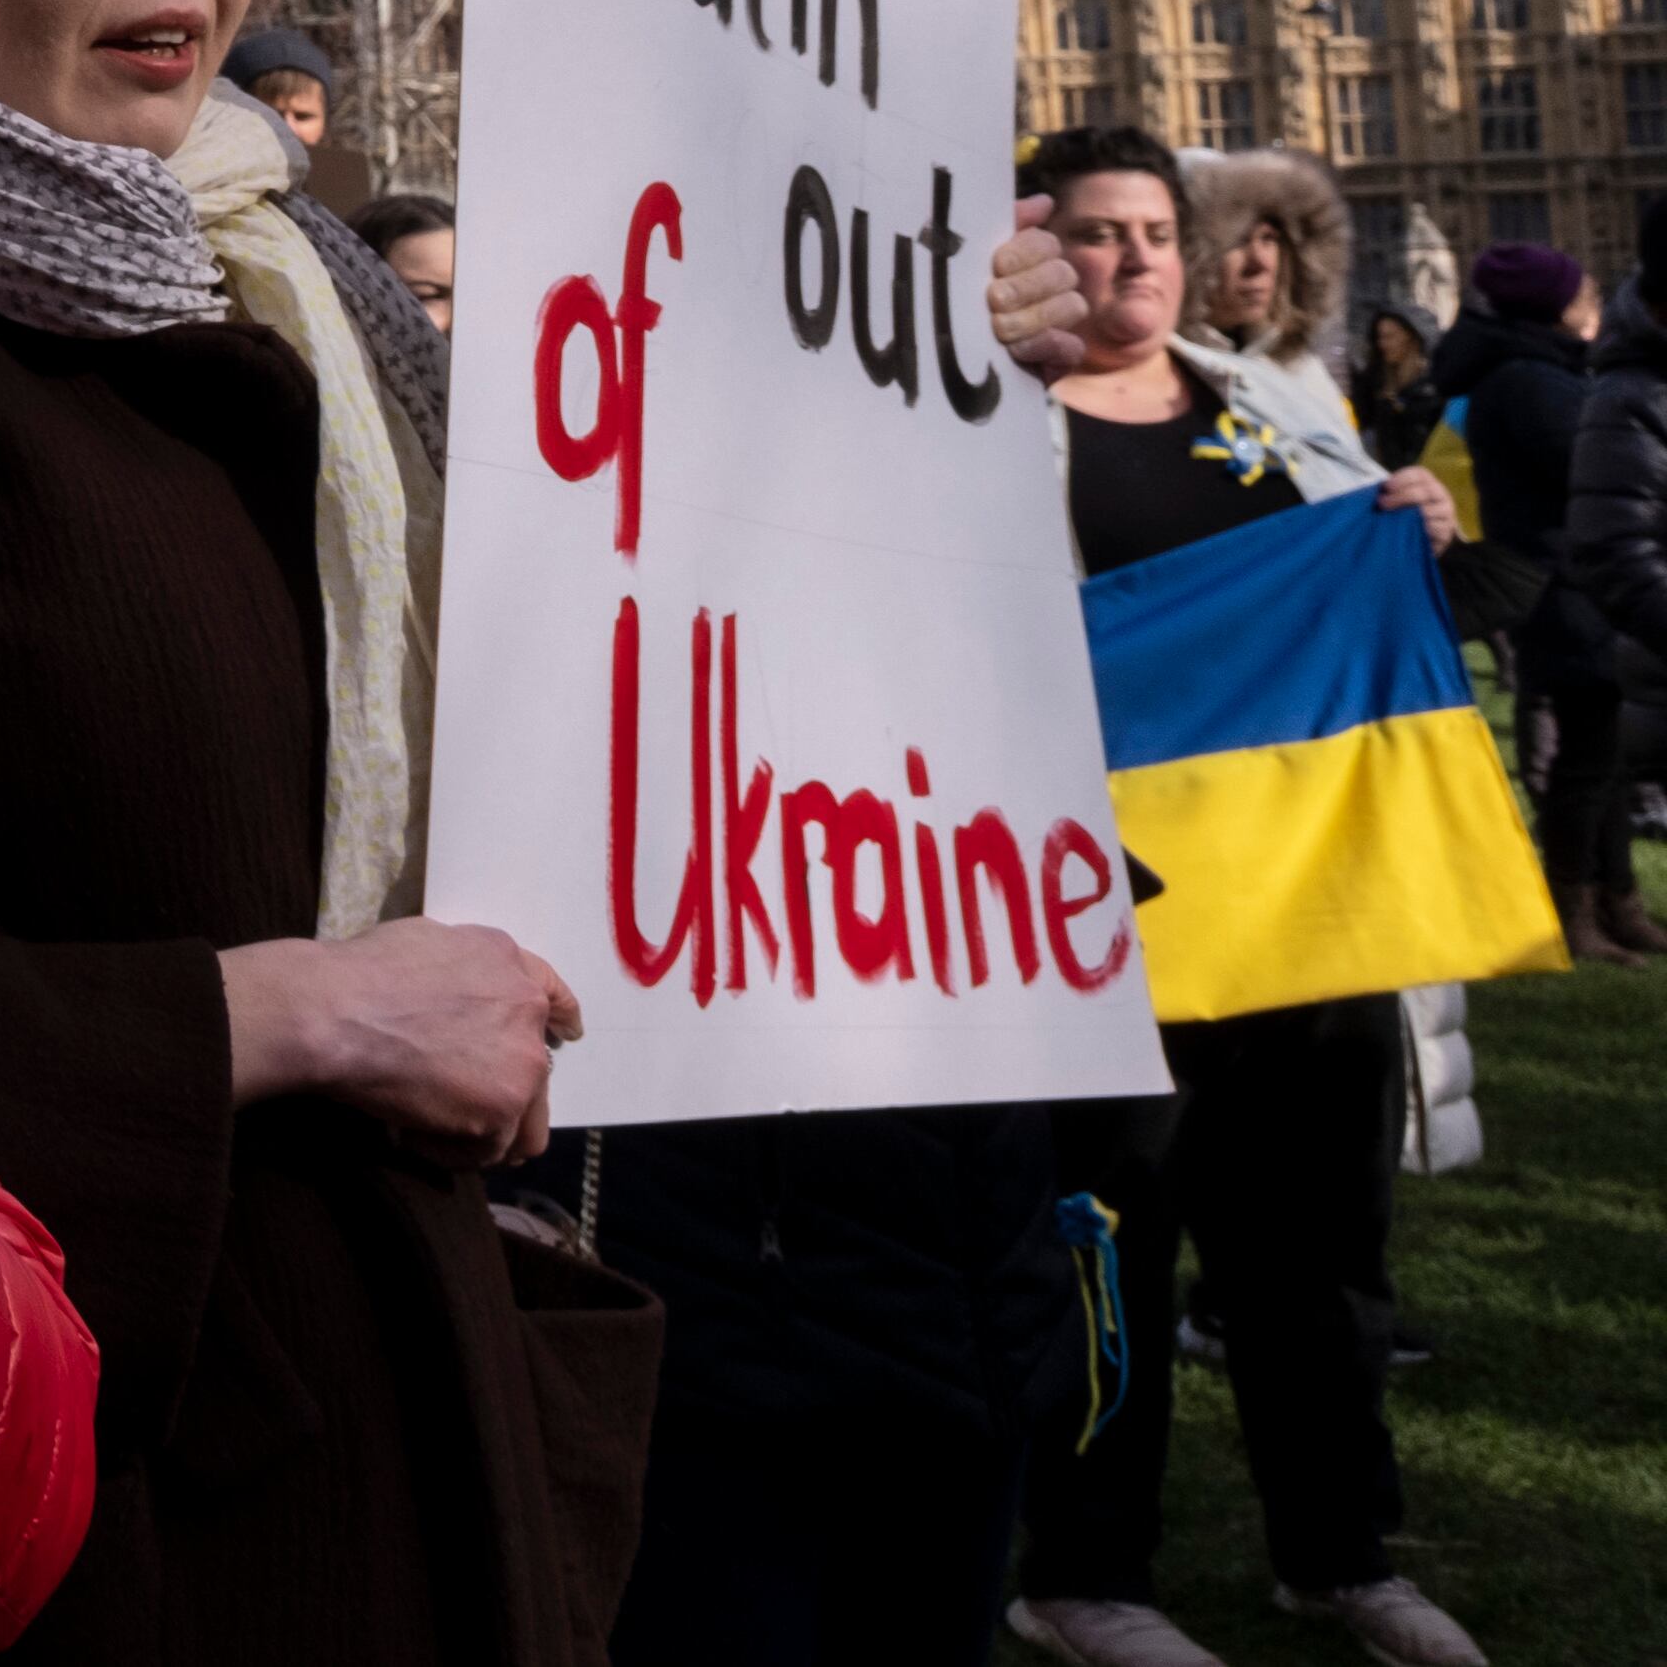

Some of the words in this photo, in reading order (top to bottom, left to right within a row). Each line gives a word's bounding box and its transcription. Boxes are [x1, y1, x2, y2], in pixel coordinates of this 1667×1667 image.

[534, 182, 683, 566] of
[783, 164, 1001, 425] out
[607, 595, 1132, 1009] Ukraine
